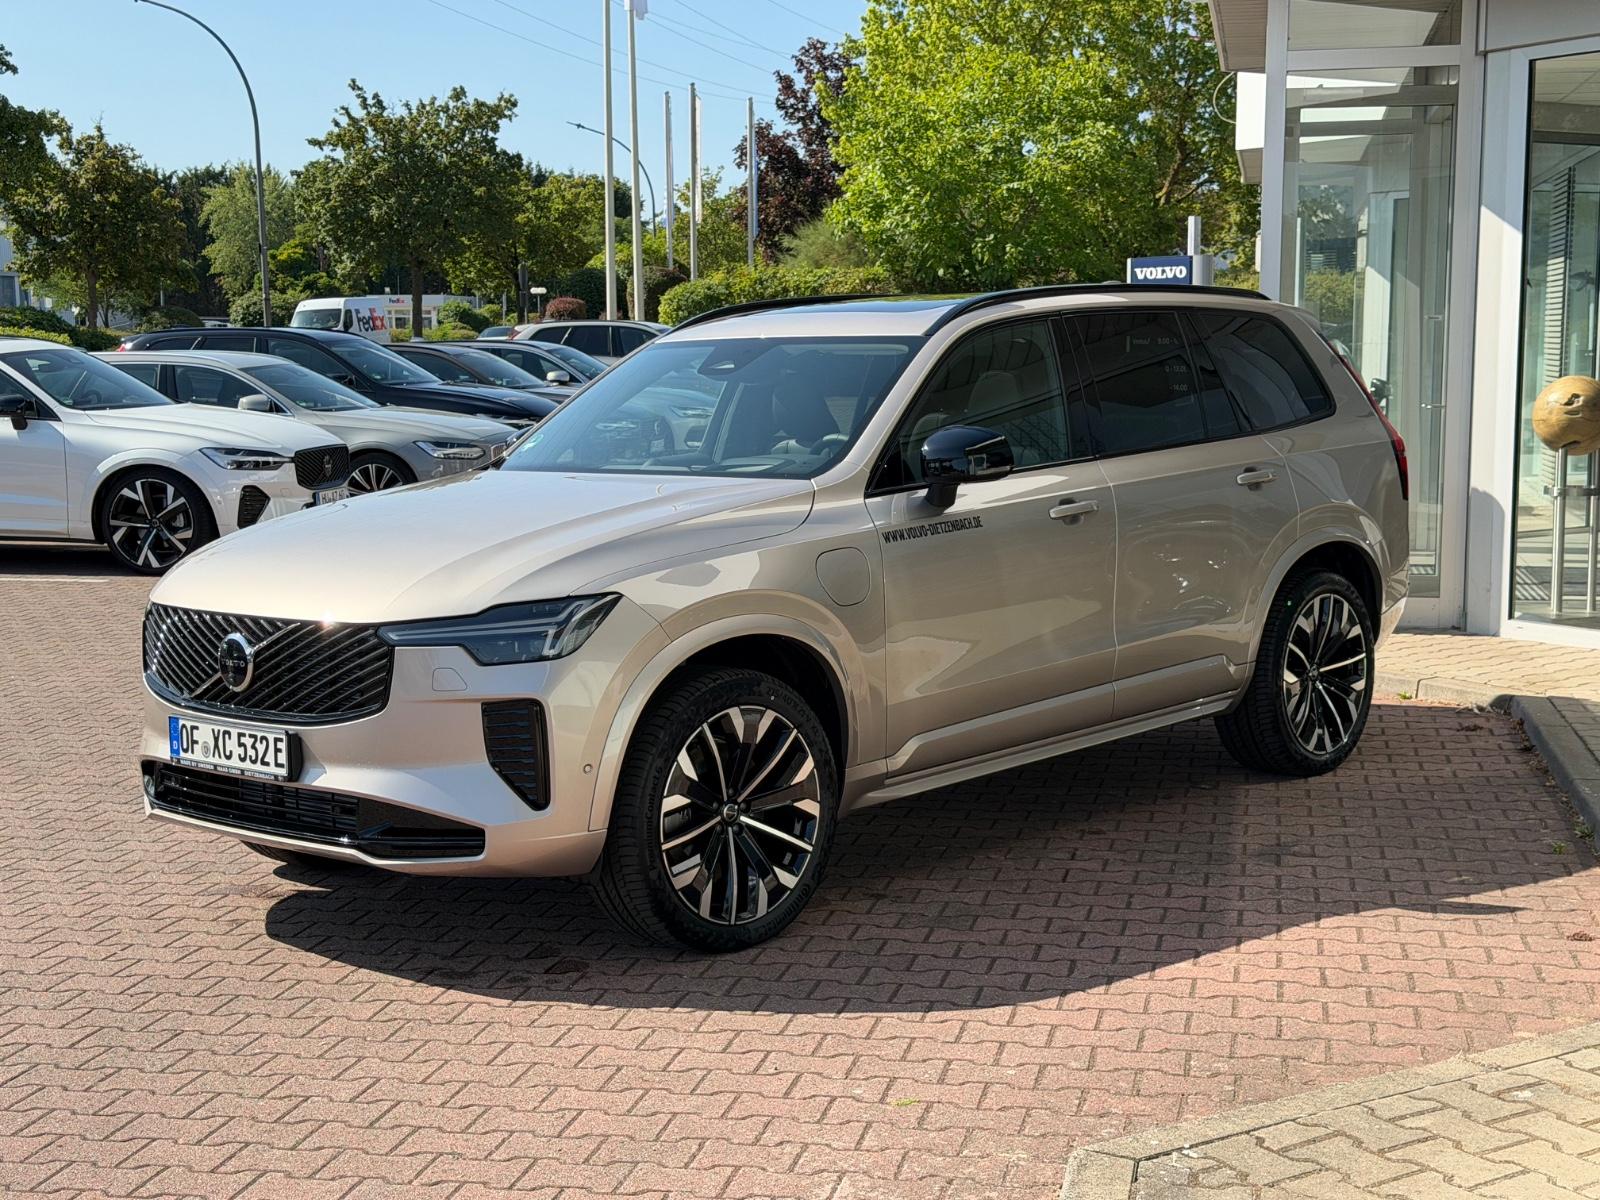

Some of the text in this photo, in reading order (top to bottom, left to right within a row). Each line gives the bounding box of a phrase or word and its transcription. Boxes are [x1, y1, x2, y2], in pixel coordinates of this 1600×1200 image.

[1134, 266, 1187, 280] VOLVO
[354, 305, 387, 333] FedEx
[882, 516, 984, 544] WWW.VOLVO-DIETZENBACH.DE
[180, 723, 200, 755] OF
[211, 727, 234, 760] XC
